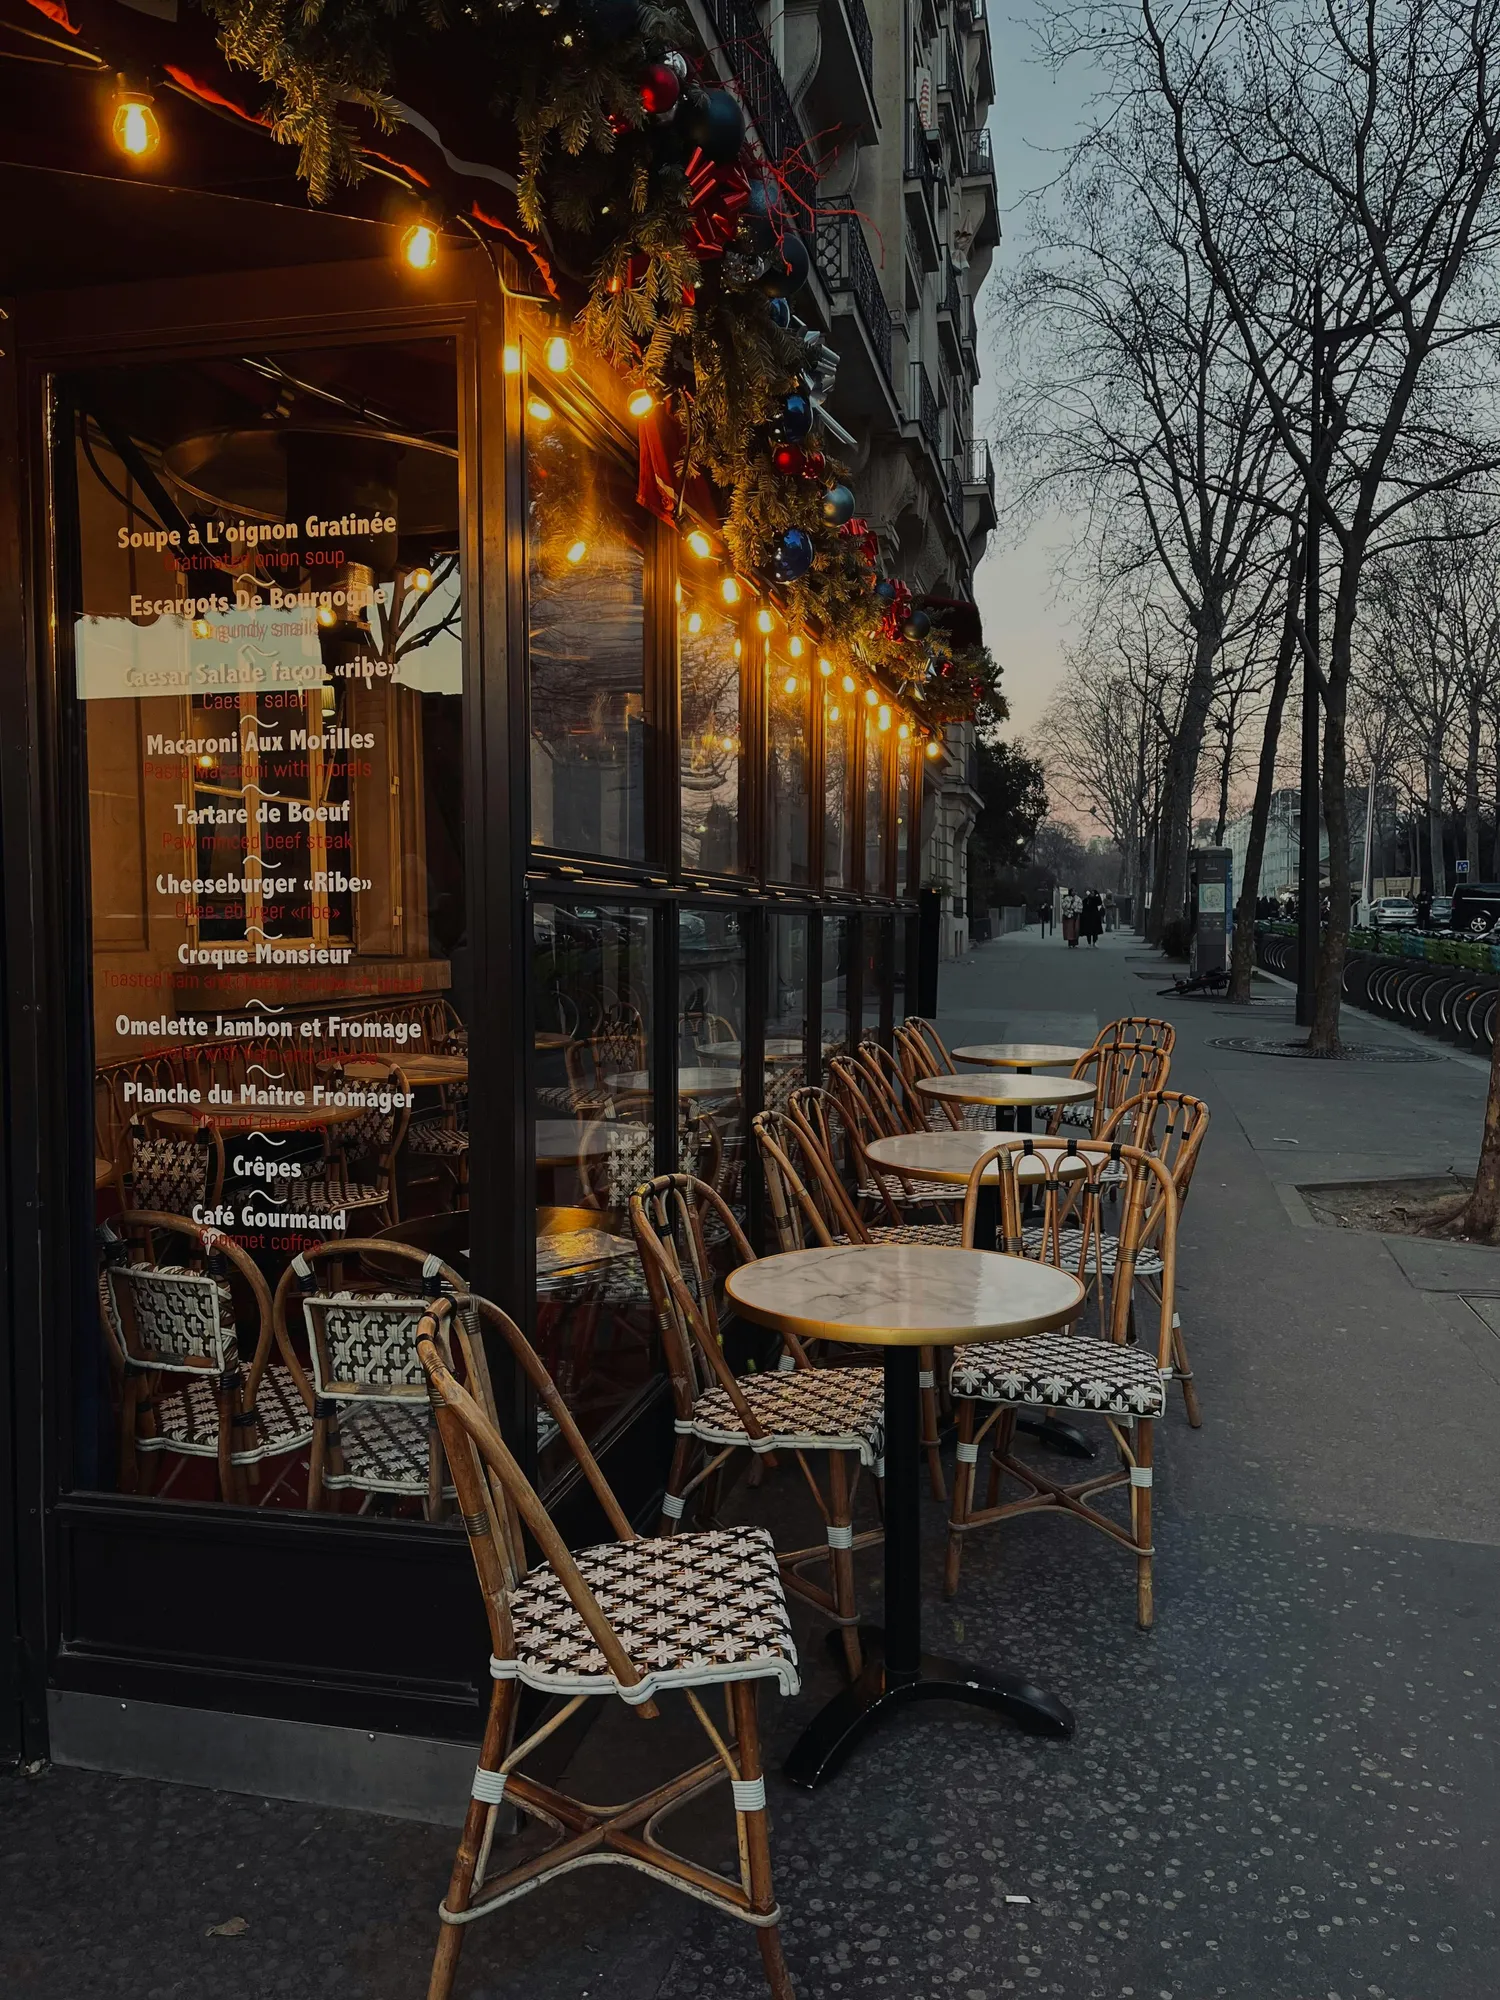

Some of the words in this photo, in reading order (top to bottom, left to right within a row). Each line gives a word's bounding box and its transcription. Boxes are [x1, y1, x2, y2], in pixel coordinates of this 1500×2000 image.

[117, 526, 181, 553] Soupe
[187, 523, 200, 545] à
[305, 511, 397, 537] Gratinée
[255, 551, 299, 567] onion
[305, 549, 346, 568] soup
[130, 594, 229, 619] Escargots
[236, 590, 263, 610] De
[269, 584, 388, 612] Bourgogne
[124, 668, 191, 687] Caesar
[195, 663, 265, 685] Salade
[264, 690, 308, 708] salad
[147, 732, 238, 755] Macaroni
[244, 732, 284, 751] Aux
[290, 728, 375, 751] Morilles
[144, 762, 189, 778] Pasta
[273, 759, 309, 777] with
[174, 803, 247, 826] Tartare
[255, 802, 281, 824] de
[288, 798, 351, 823] Boeuf
[265, 831, 301, 849] beef
[306, 831, 353, 849] steak
[156, 873, 298, 900] Cheeseburger
[177, 944, 248, 970] Croque
[255, 943, 352, 965] Monsieur
[103, 969, 162, 988] Toasted
[115, 1014, 209, 1038] Omelette
[214, 1015, 293, 1038] Jambon
[299, 1017, 322, 1038] et
[329, 1016, 422, 1045] Fromage
[123, 1082, 201, 1105] Planche
[207, 1083, 233, 1105] du
[240, 1082, 306, 1106] Maître
[312, 1086, 415, 1114] Fromager
[237, 1113, 254, 1128] of
[232, 1154, 302, 1183] Crêpes
[192, 1204, 235, 1227] Café
[241, 1206, 346, 1231] Gourmand
